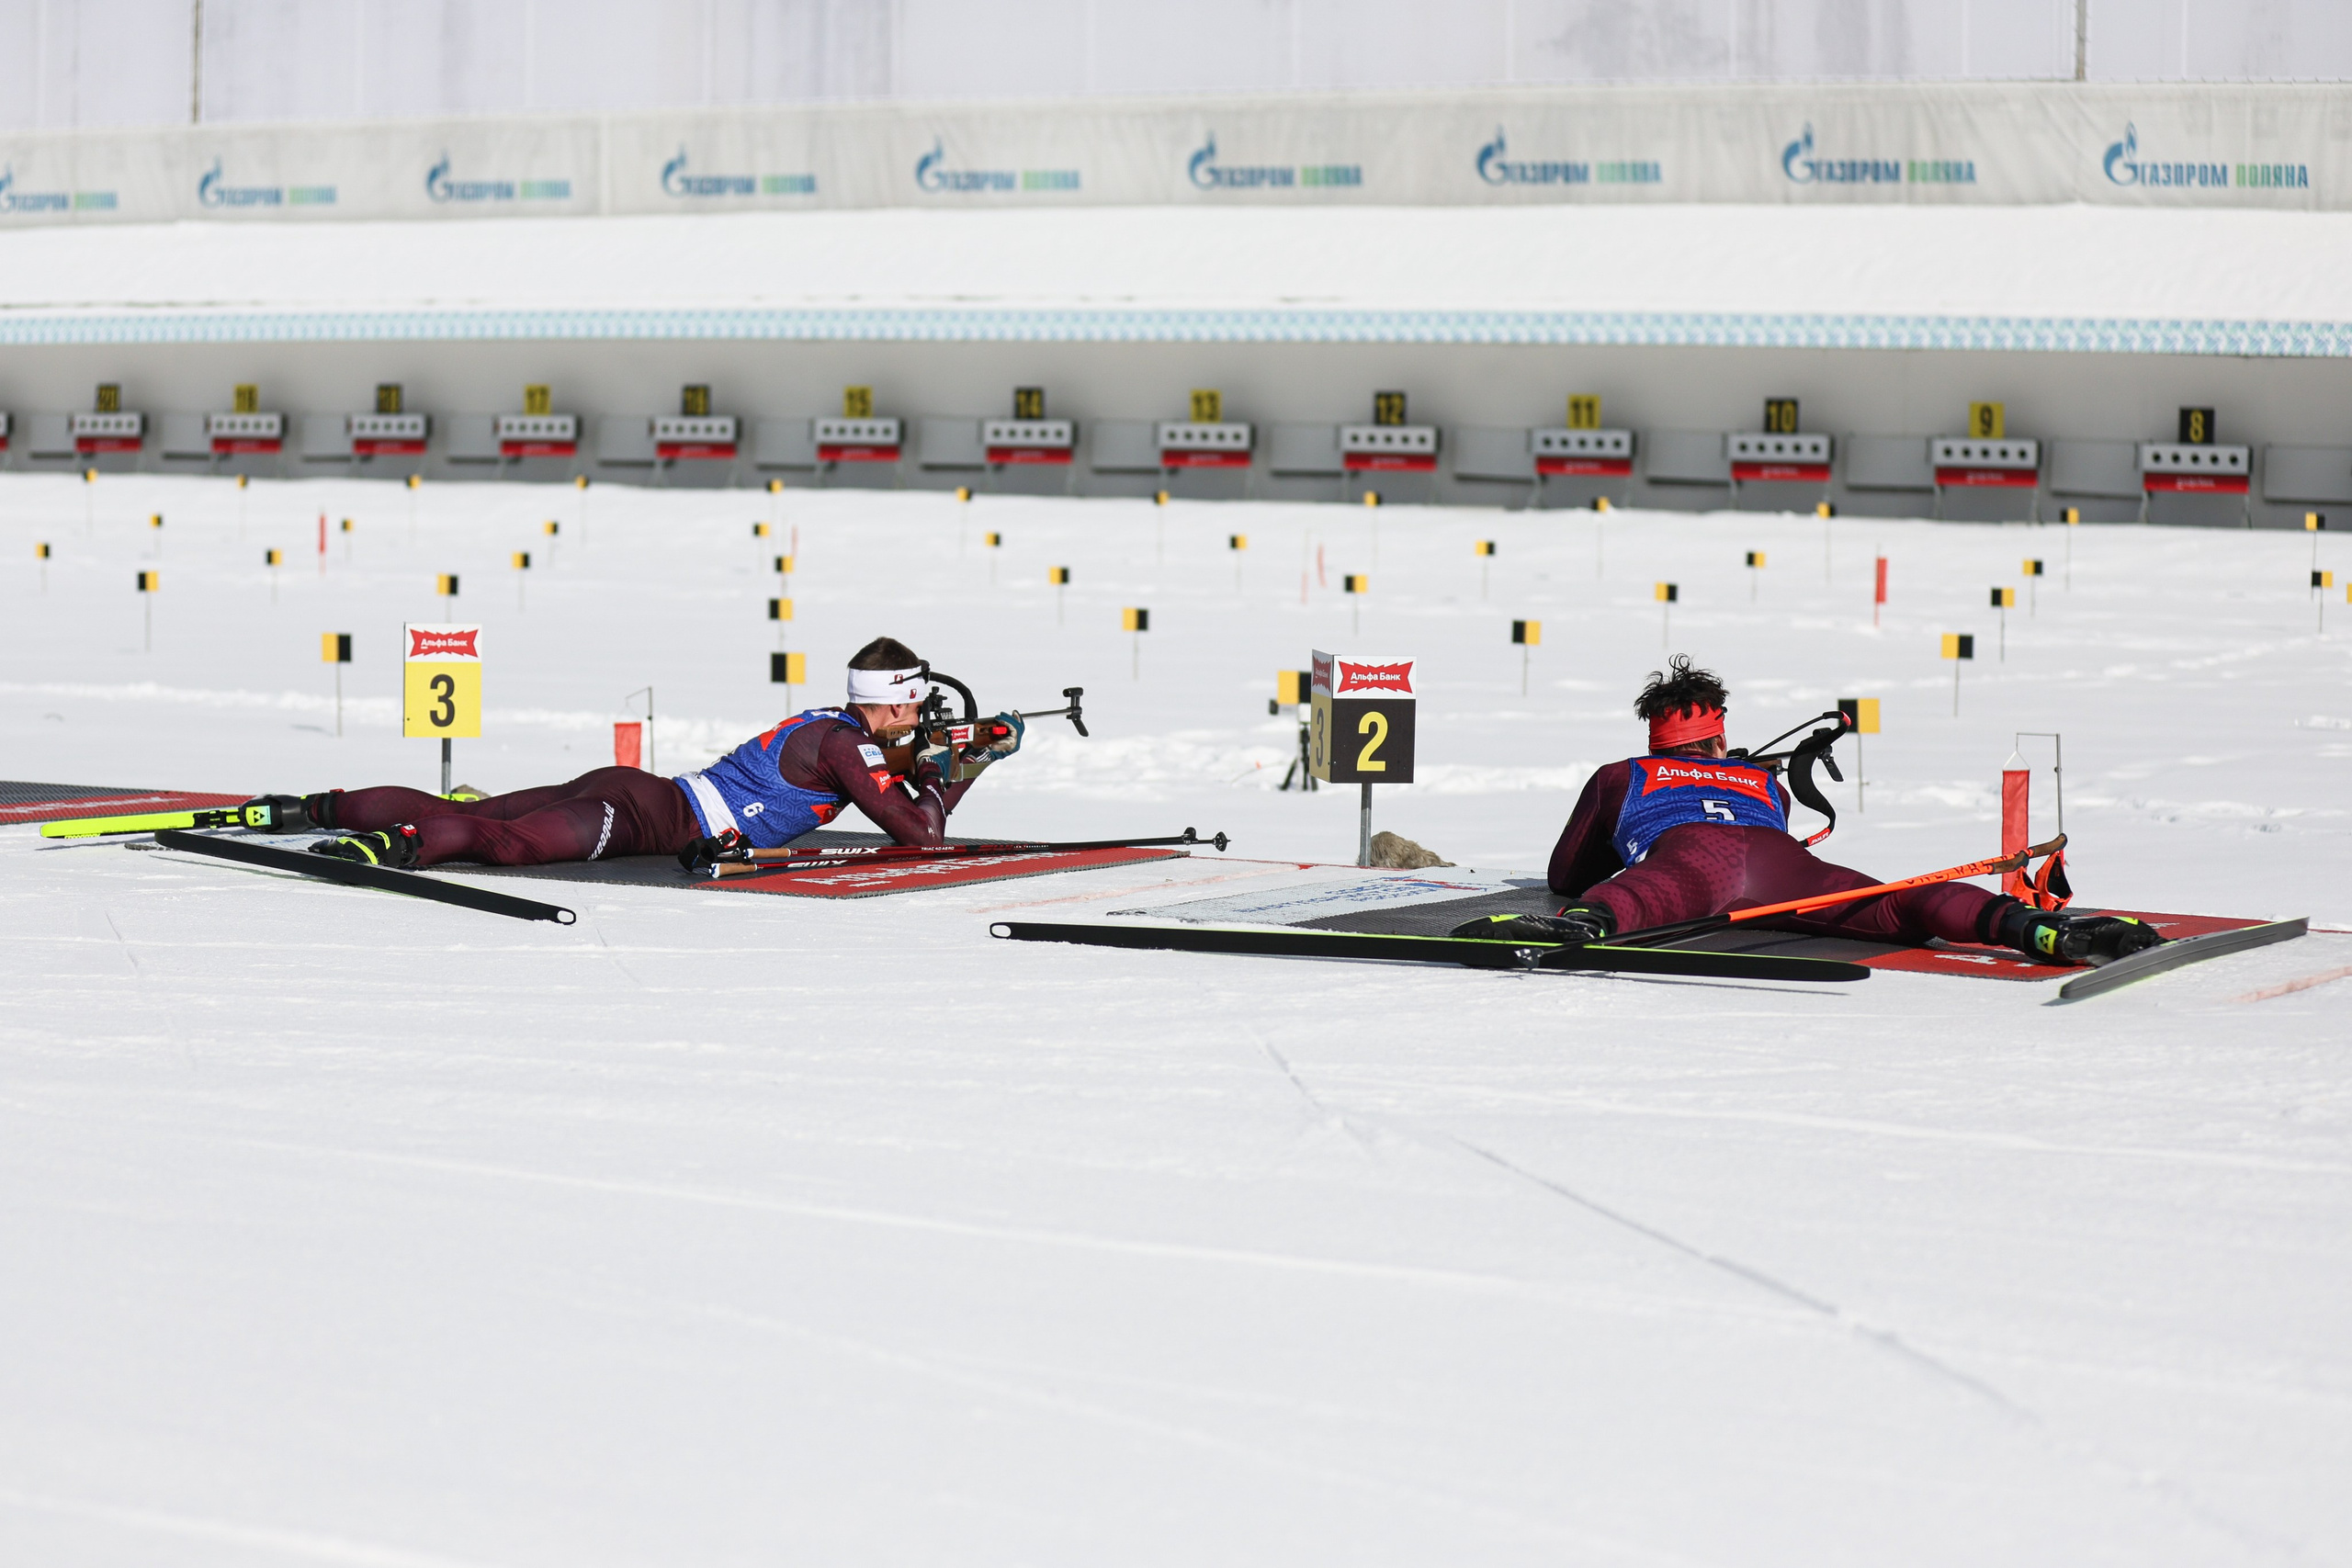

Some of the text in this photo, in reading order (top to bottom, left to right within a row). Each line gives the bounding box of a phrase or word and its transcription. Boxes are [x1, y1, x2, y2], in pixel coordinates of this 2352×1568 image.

[2235, 164, 2309, 188] ПОЛЯНА
[1377, 395, 1404, 424] 12
[1570, 400, 1594, 426] 11
[1768, 401, 1796, 432] 10
[1980, 406, 1993, 435] 9
[2189, 410, 2204, 443] 8
[421, 638, 468, 649] Альфа Банк
[1351, 672, 1401, 683] Альфа Банк
[430, 674, 455, 728] 3
[1316, 707, 1324, 768] 3
[1356, 711, 1388, 772] 2
[1657, 766, 1759, 789] Альфа Банк
[742, 802, 764, 818] 6
[1701, 798, 1736, 821] 5
[819, 847, 881, 855] SWIX
[1626, 838, 1638, 854] 5
